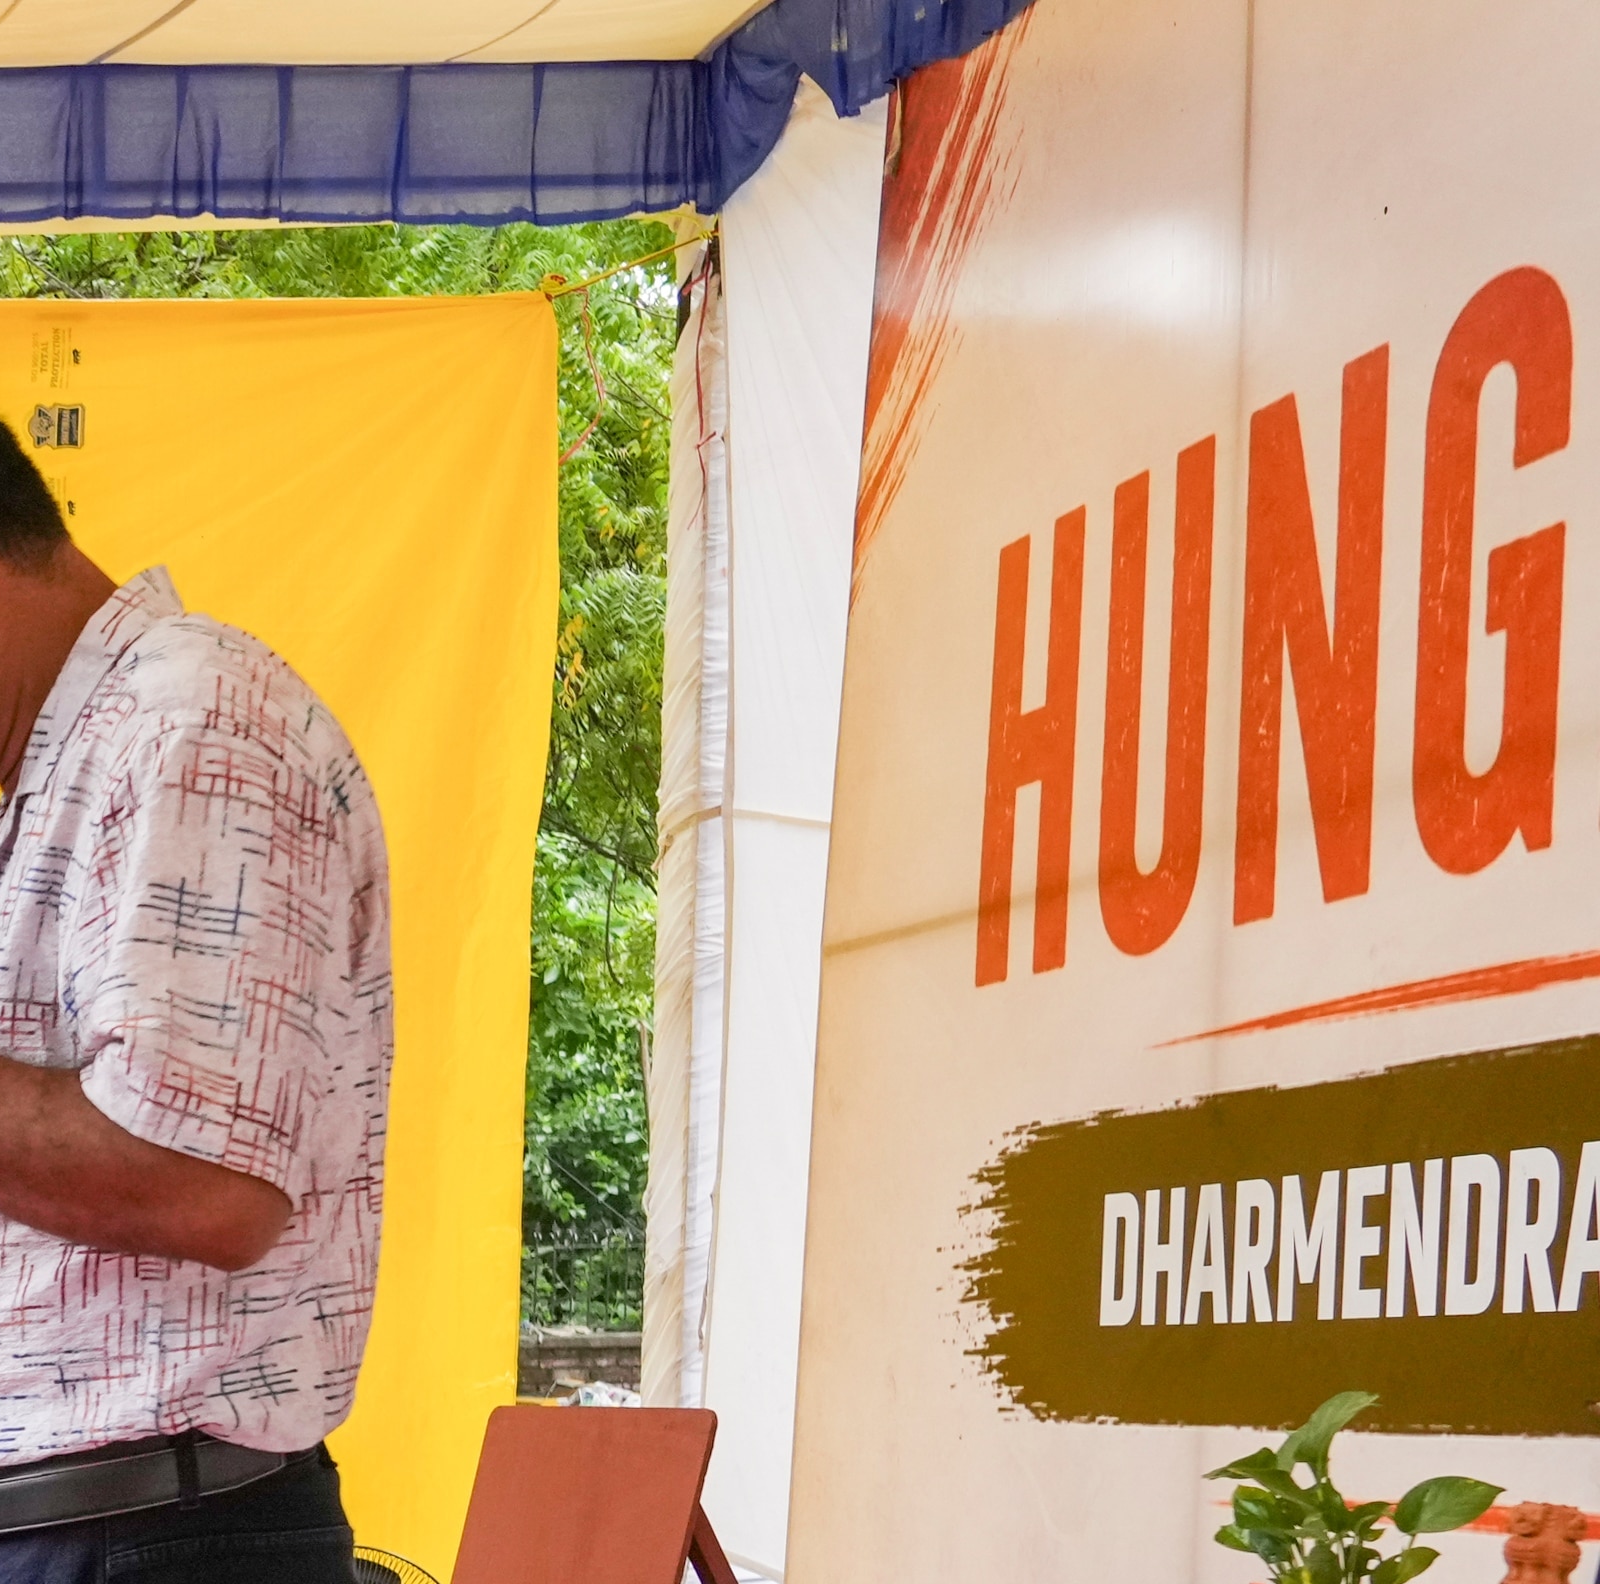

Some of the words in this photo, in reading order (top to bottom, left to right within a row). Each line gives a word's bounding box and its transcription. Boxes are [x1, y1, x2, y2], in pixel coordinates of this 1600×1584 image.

[40, 341, 49, 373] TOTAL
[50, 327, 61, 388] PROTECTION
[974, 265, 1600, 987] HUNG
[1099, 1140, 1600, 1327] DHARMENDRA
